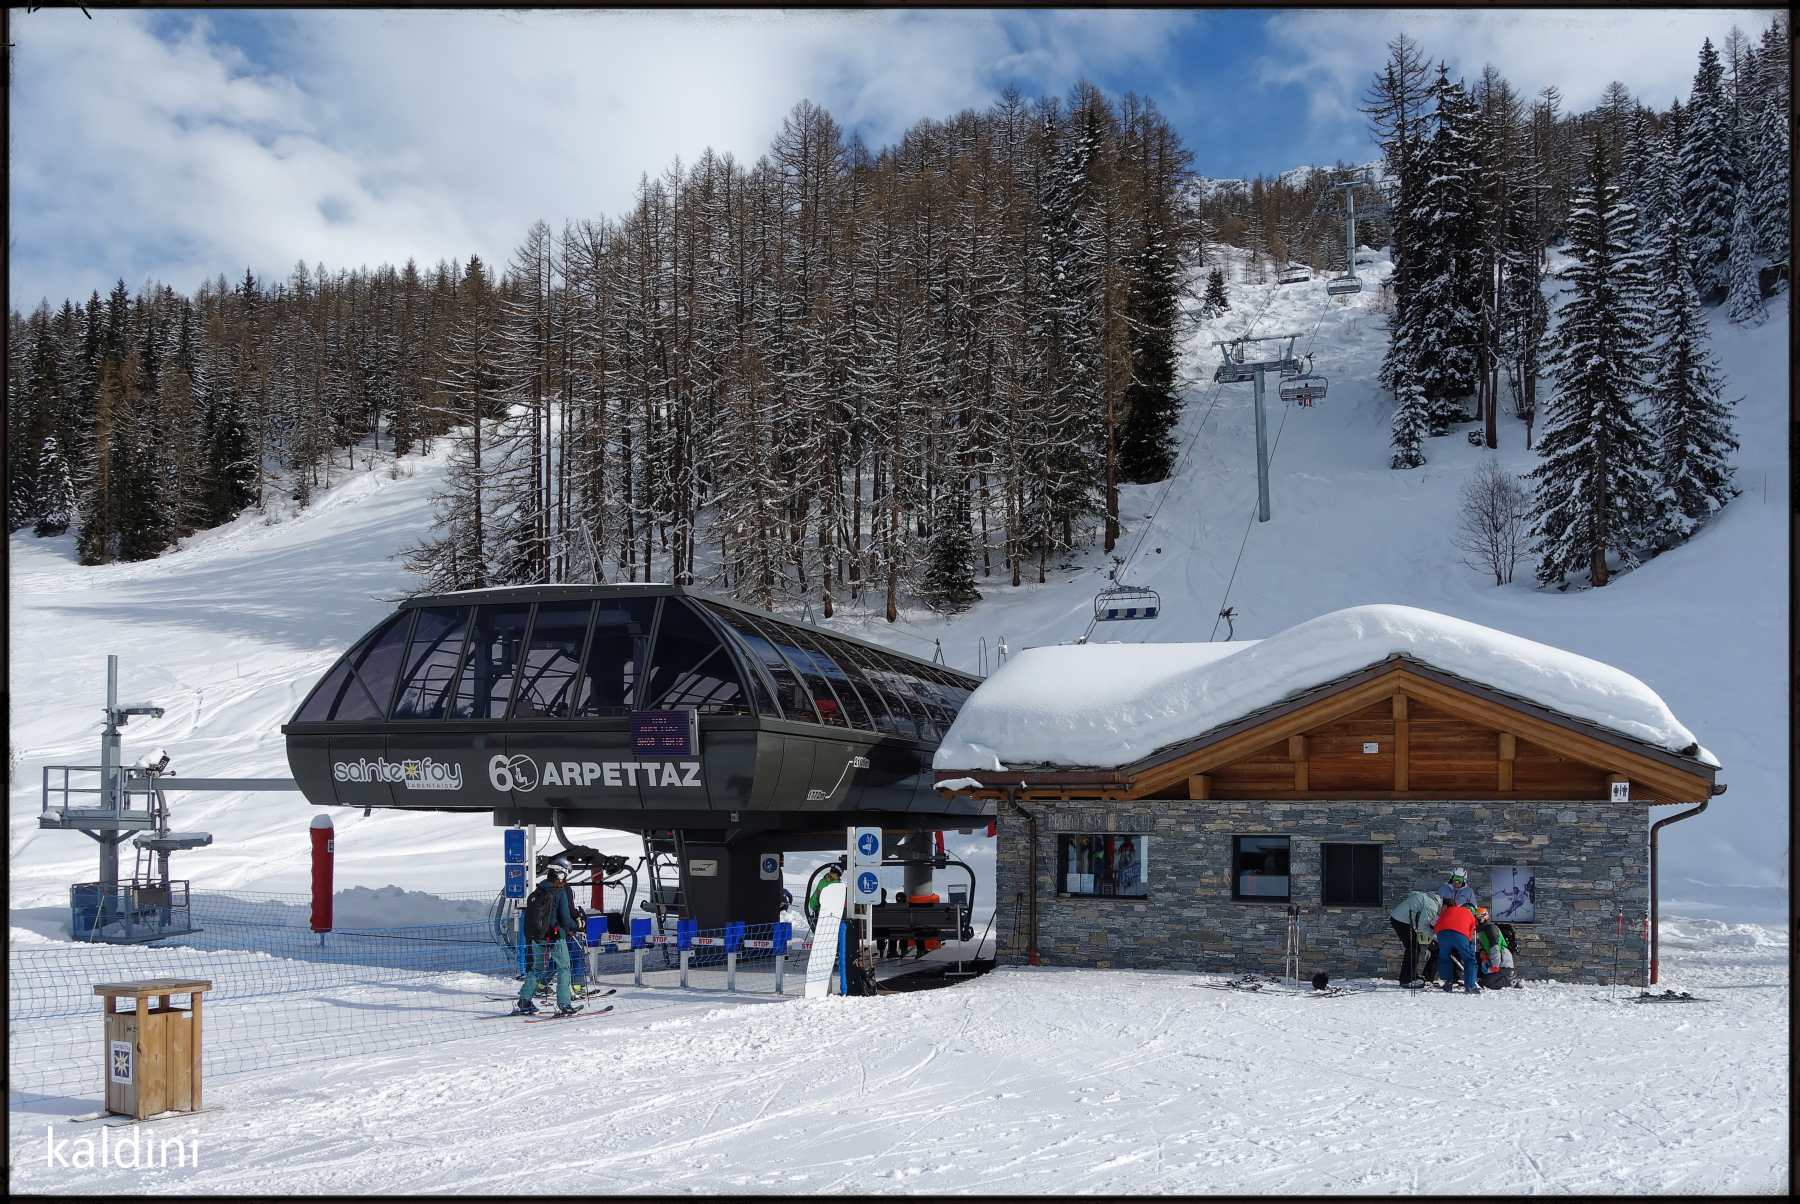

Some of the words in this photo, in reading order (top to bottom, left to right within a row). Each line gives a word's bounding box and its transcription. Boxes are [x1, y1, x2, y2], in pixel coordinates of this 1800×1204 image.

[334, 757, 403, 782] sainte
[421, 757, 462, 790] foy
[542, 761, 701, 787] ARPETTAZ
